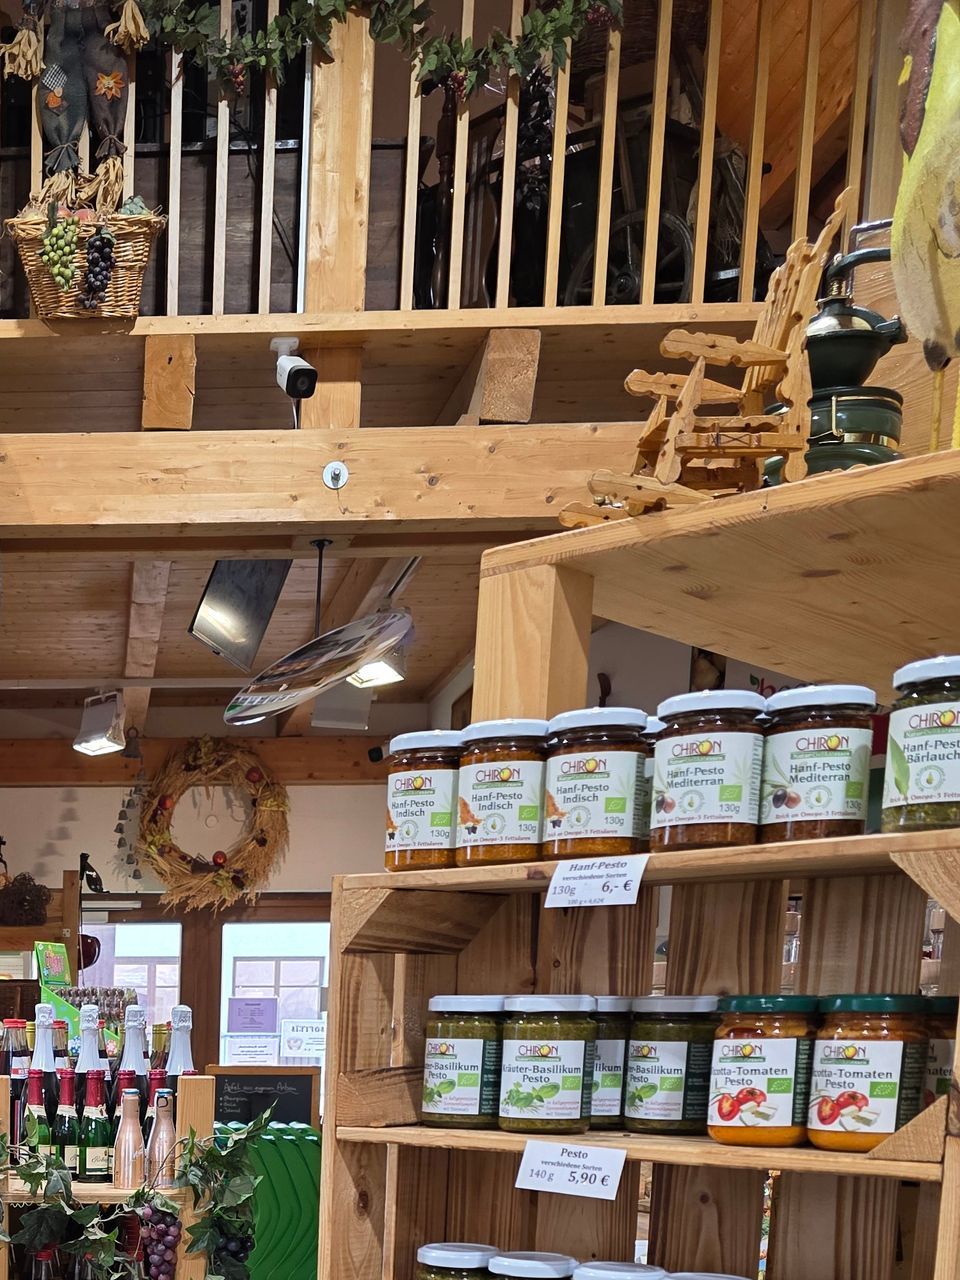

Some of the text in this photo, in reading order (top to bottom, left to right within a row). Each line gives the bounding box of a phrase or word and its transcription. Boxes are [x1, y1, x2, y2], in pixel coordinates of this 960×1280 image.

[672, 739, 722, 758] CHIRON
[796, 734, 850, 752] CHIRON
[561, 759, 607, 774] CHIRON
[666, 766, 724, 778] Hanf-Pesto
[790, 762, 851, 773] Hanf-Pesto
[475, 766, 521, 782] CHIRON
[789, 772, 850, 784] Mediterran
[395, 775, 432, 791] CHIRON
[666, 776, 724, 789] Mediterran
[556, 783, 609, 795] Hanf-Pesto
[471, 791, 523, 803] Hanf-Pesto
[563, 792, 599, 803] Indisch
[391, 799, 434, 808] Hanf-Pesto
[478, 801, 513, 811] Indisch
[719, 803, 740, 814] 130g
[846, 800, 862, 811] 130g
[396, 808, 425, 818] Indisch
[604, 816, 624, 826] 130g
[430, 829, 450, 839] 130g
[518, 824, 536, 833] 130g
[569, 861, 627, 871] Hanf-Pesto
[552, 880, 633, 896] 130g 6,- €
[518, 1044, 558, 1057] CHIRON
[721, 1042, 762, 1057] CHIRON
[823, 1044, 866, 1059] CHIRON
[522, 1074, 550, 1083] Pesto
[630, 1075, 649, 1083] Pesto
[725, 1076, 752, 1086] Pesto
[825, 1079, 855, 1089] Pesto
[560, 1148, 589, 1160] Pesto
[541, 1160, 603, 1172] verschiedene Sorten
[529, 1168, 610, 1187] 140 g 5,90 €
